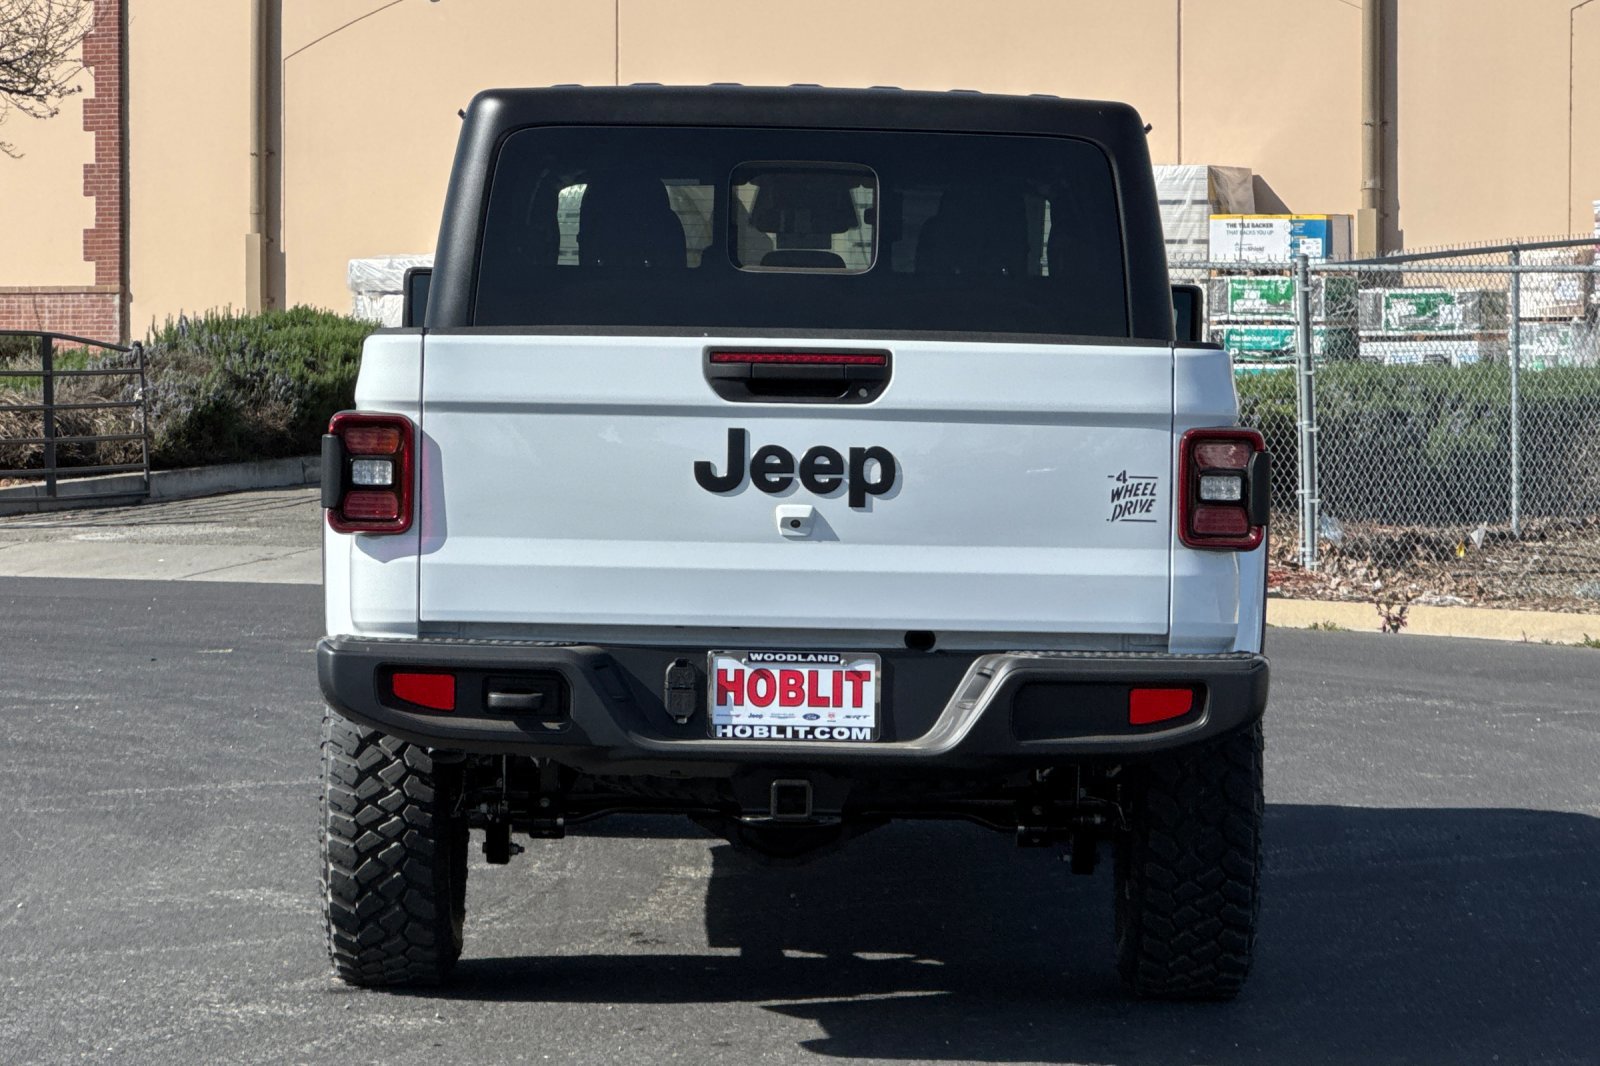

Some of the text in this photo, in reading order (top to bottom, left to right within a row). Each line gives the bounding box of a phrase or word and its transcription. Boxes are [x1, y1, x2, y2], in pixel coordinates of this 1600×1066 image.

[694, 428, 896, 508] Jeep
[1116, 470, 1127, 484] 4
[1111, 482, 1157, 503] WHEEL
[1110, 498, 1156, 522] DRIVE
[750, 653, 840, 662] WOODLAND
[716, 668, 871, 708] HOBLIT
[716, 726, 871, 740] HOBLIT.COM
